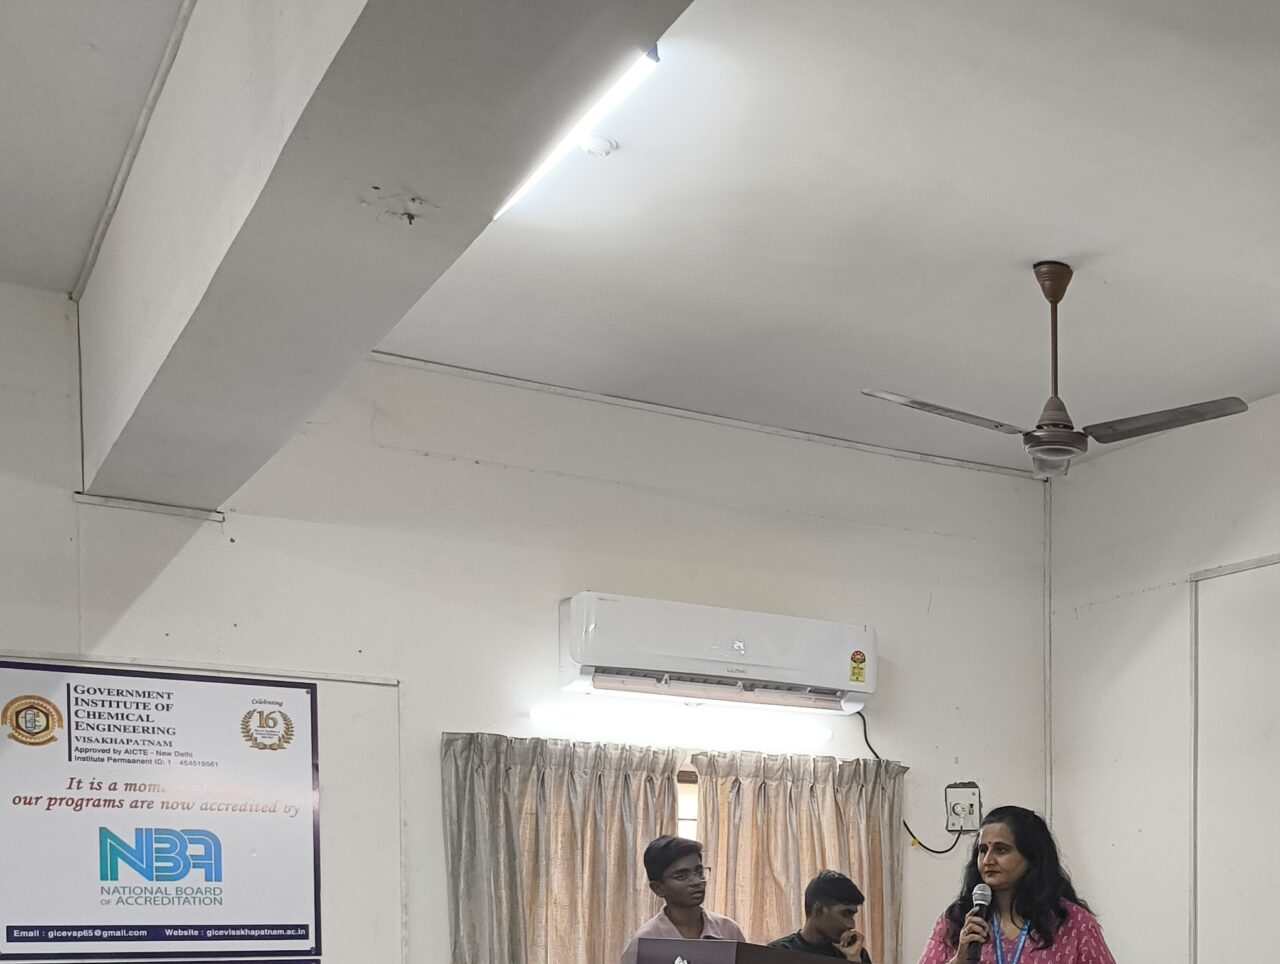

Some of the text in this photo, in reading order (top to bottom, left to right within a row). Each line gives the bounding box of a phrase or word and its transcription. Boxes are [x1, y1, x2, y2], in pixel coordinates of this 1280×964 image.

[73, 684, 174, 700] GOVERNMENT
[74, 697, 174, 712] INSTITUTE OF
[74, 708, 155, 723] CHEMICAL
[256, 710, 278, 728] 16
[74, 720, 177, 736] ENGINEERING
[74, 735, 173, 748] VISAKHAPATNAM
[74, 746, 111, 756] Approved
[113, 747, 122, 757] by
[124, 748, 148, 756] AICTE
[174, 750, 193, 758] Delhi
[74, 755, 105, 763] Institute
[66, 777, 83, 790] It
[89, 778, 103, 791] is
[108, 782, 118, 791] a
[11, 795, 43, 806] our
[45, 796, 124, 811] programs
[129, 798, 155, 810] are
[160, 799, 195, 811] now
[200, 800, 277, 814] accredited
[99, 826, 223, 882] NBA
[100, 886, 223, 896] NATIONAL BOARD
[115, 896, 223, 906] ACCREDITATION
[13, 929, 39, 937] Email
[164, 928, 199, 936] Website
